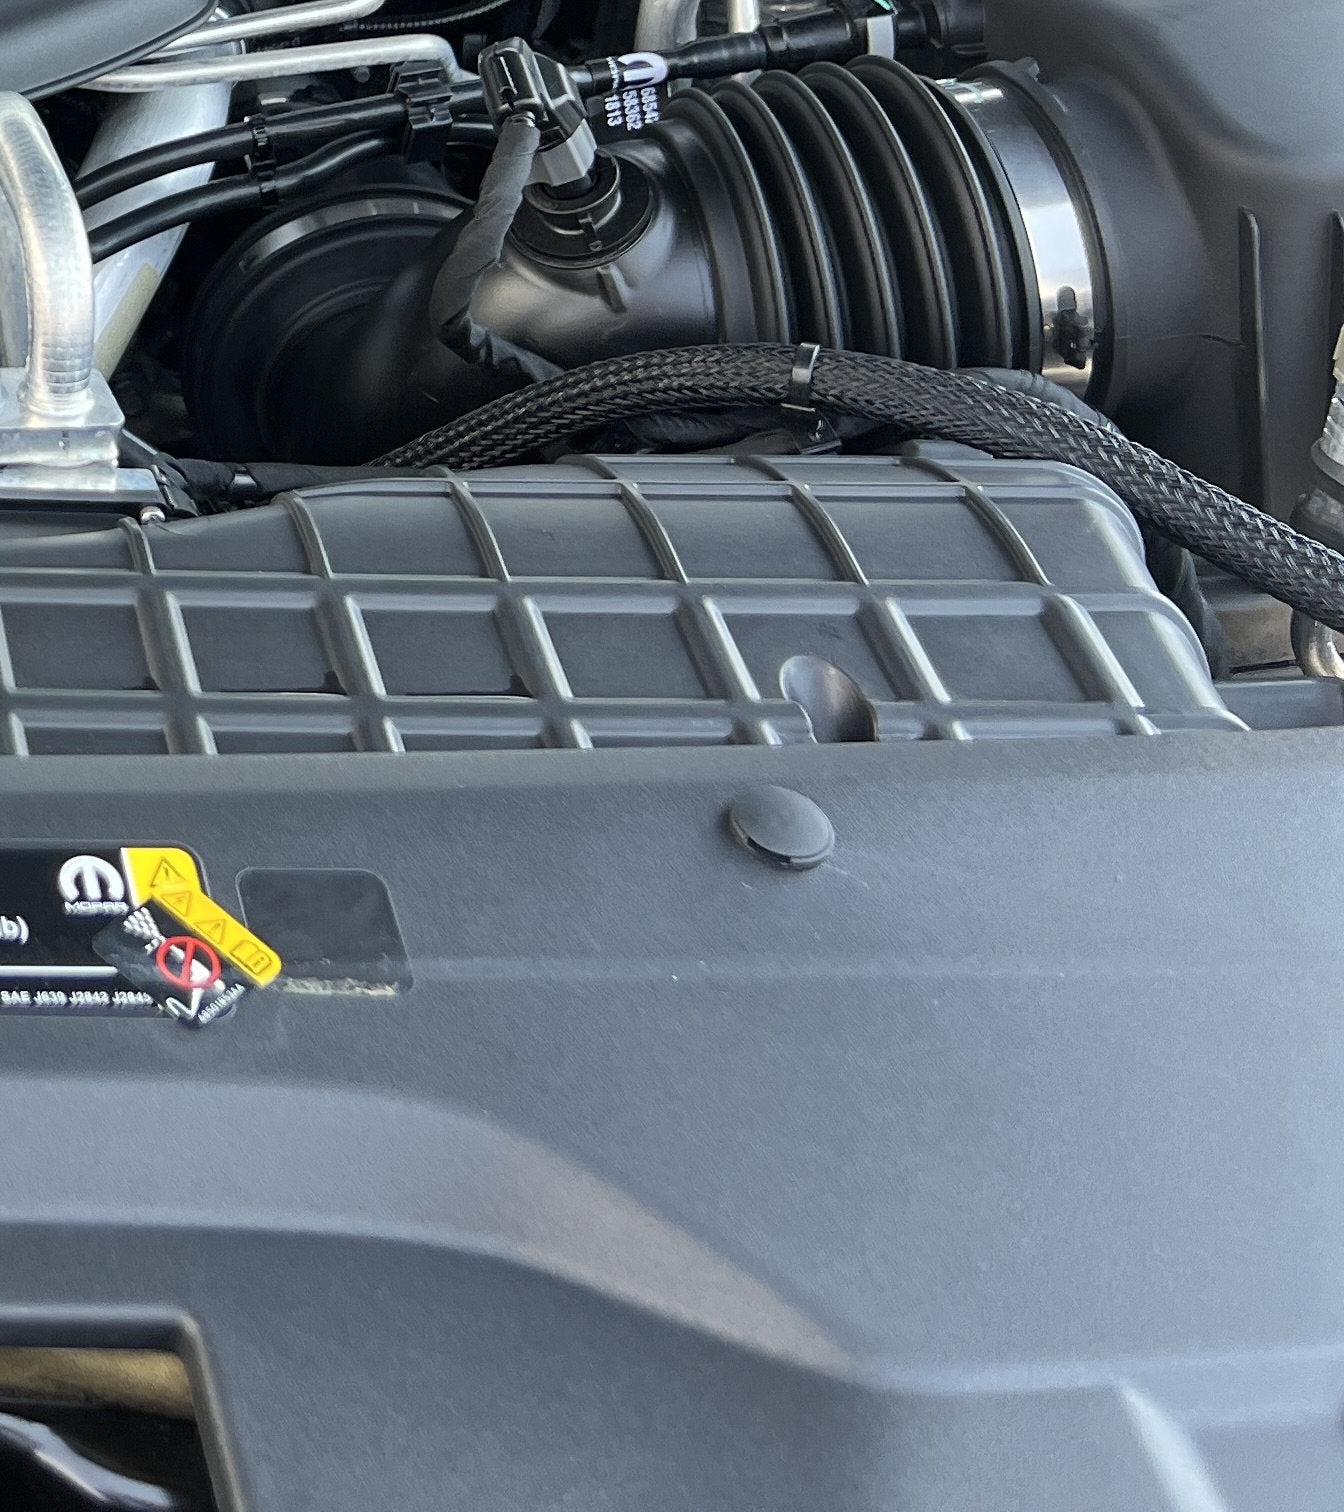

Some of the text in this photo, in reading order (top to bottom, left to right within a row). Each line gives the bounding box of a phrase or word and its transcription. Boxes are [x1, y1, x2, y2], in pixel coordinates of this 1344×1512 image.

[604, 94, 623, 127] 1813
[64, 901, 130, 915] MOPAR
[0, 990, 32, 1005] SAE
